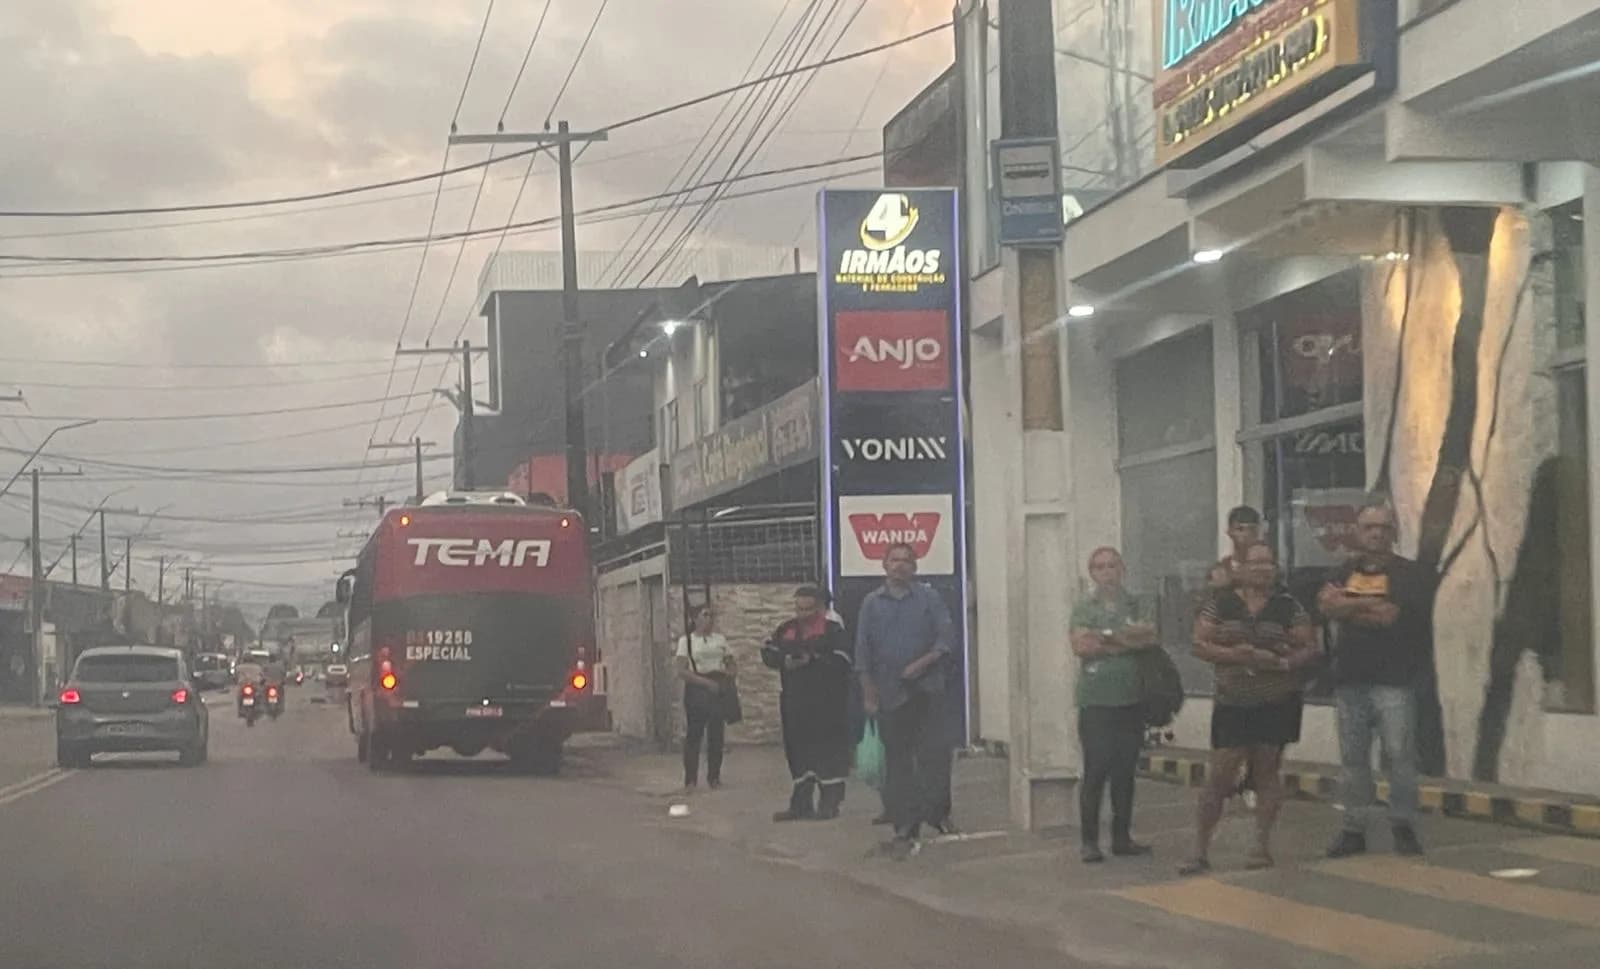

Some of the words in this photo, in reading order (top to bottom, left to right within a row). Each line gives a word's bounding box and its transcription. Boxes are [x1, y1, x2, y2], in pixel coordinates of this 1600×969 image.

[849, 336, 941, 369] ANJO
[840, 437, 947, 460] VONIXX
[862, 530, 928, 545] WANDA
[407, 538, 551, 567] TEMA
[406, 646, 472, 660] ESPECIAL
